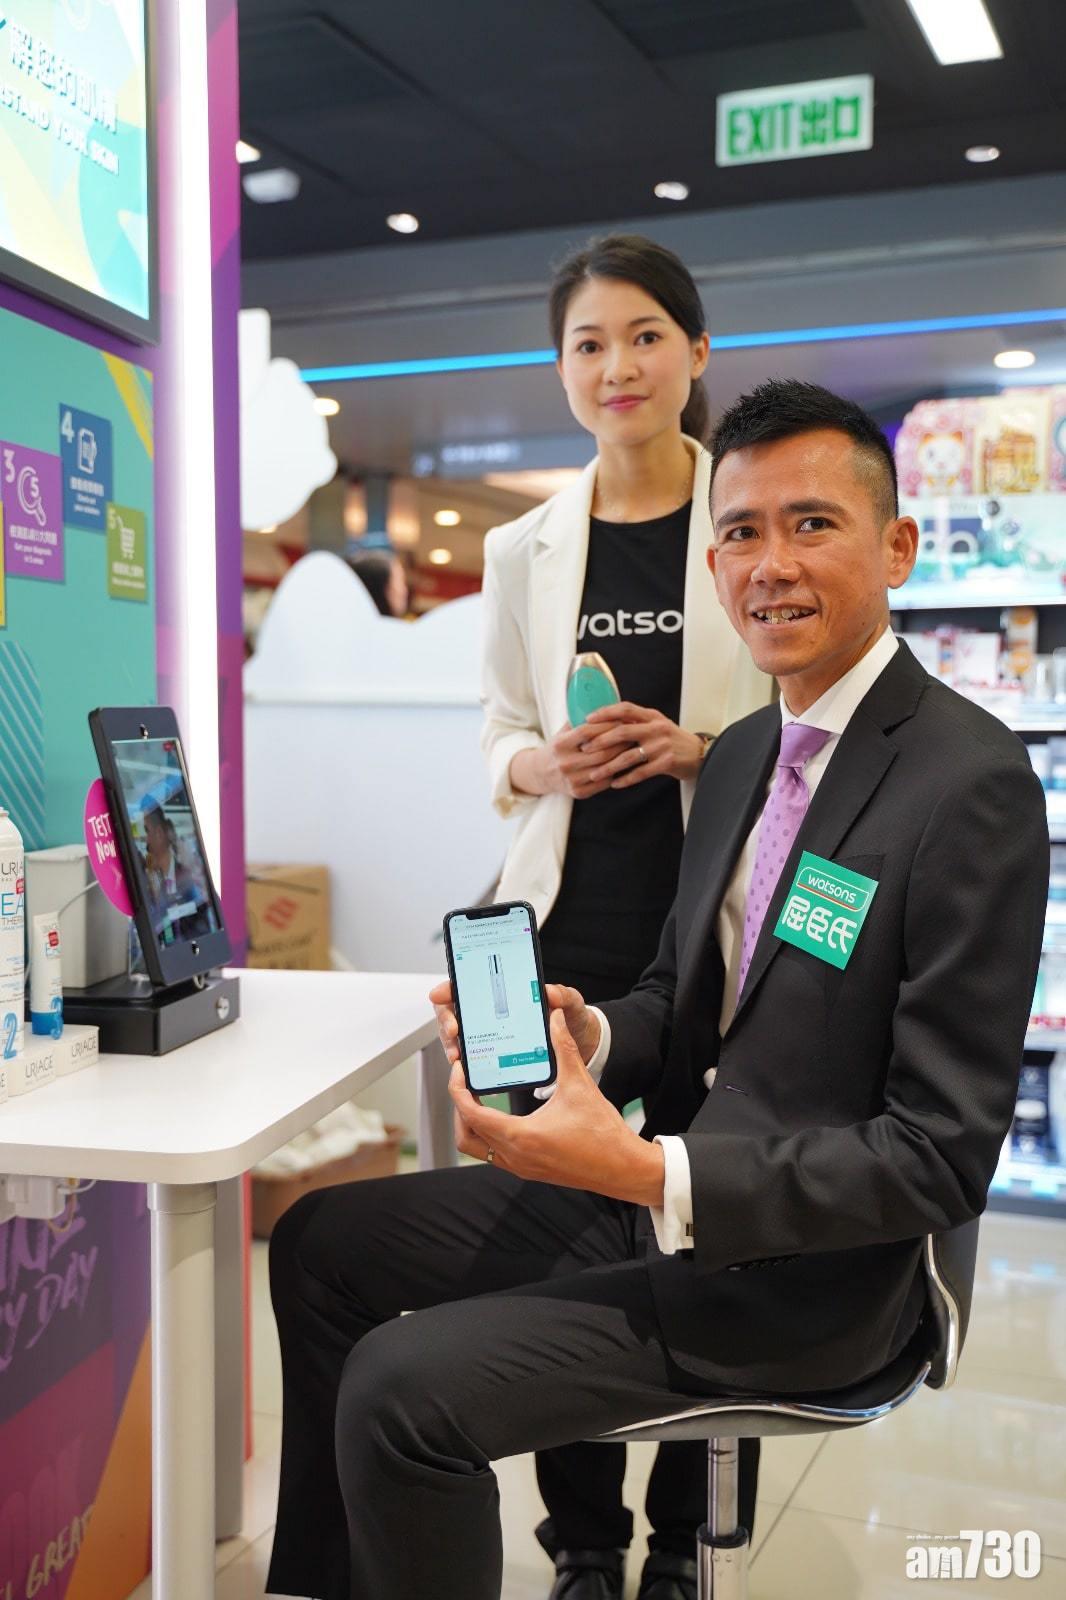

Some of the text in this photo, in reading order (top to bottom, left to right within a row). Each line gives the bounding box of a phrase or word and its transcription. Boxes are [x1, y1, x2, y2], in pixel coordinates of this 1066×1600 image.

[728, 96, 860, 157] EXIT 出口
[61, 411, 74, 443] 4
[4, 449, 15, 483] 3
[31, 476, 40, 498] 5
[107, 507, 116, 530] 5
[578, 609, 684, 640] atso
[808, 874, 857, 904] watsons
[781, 895, 858, 954] 屈臣氏
[4, 1013, 17, 1059] 2
[25, 1056, 53, 1078] URIAGE
[25, 1246, 98, 1349] DAY
